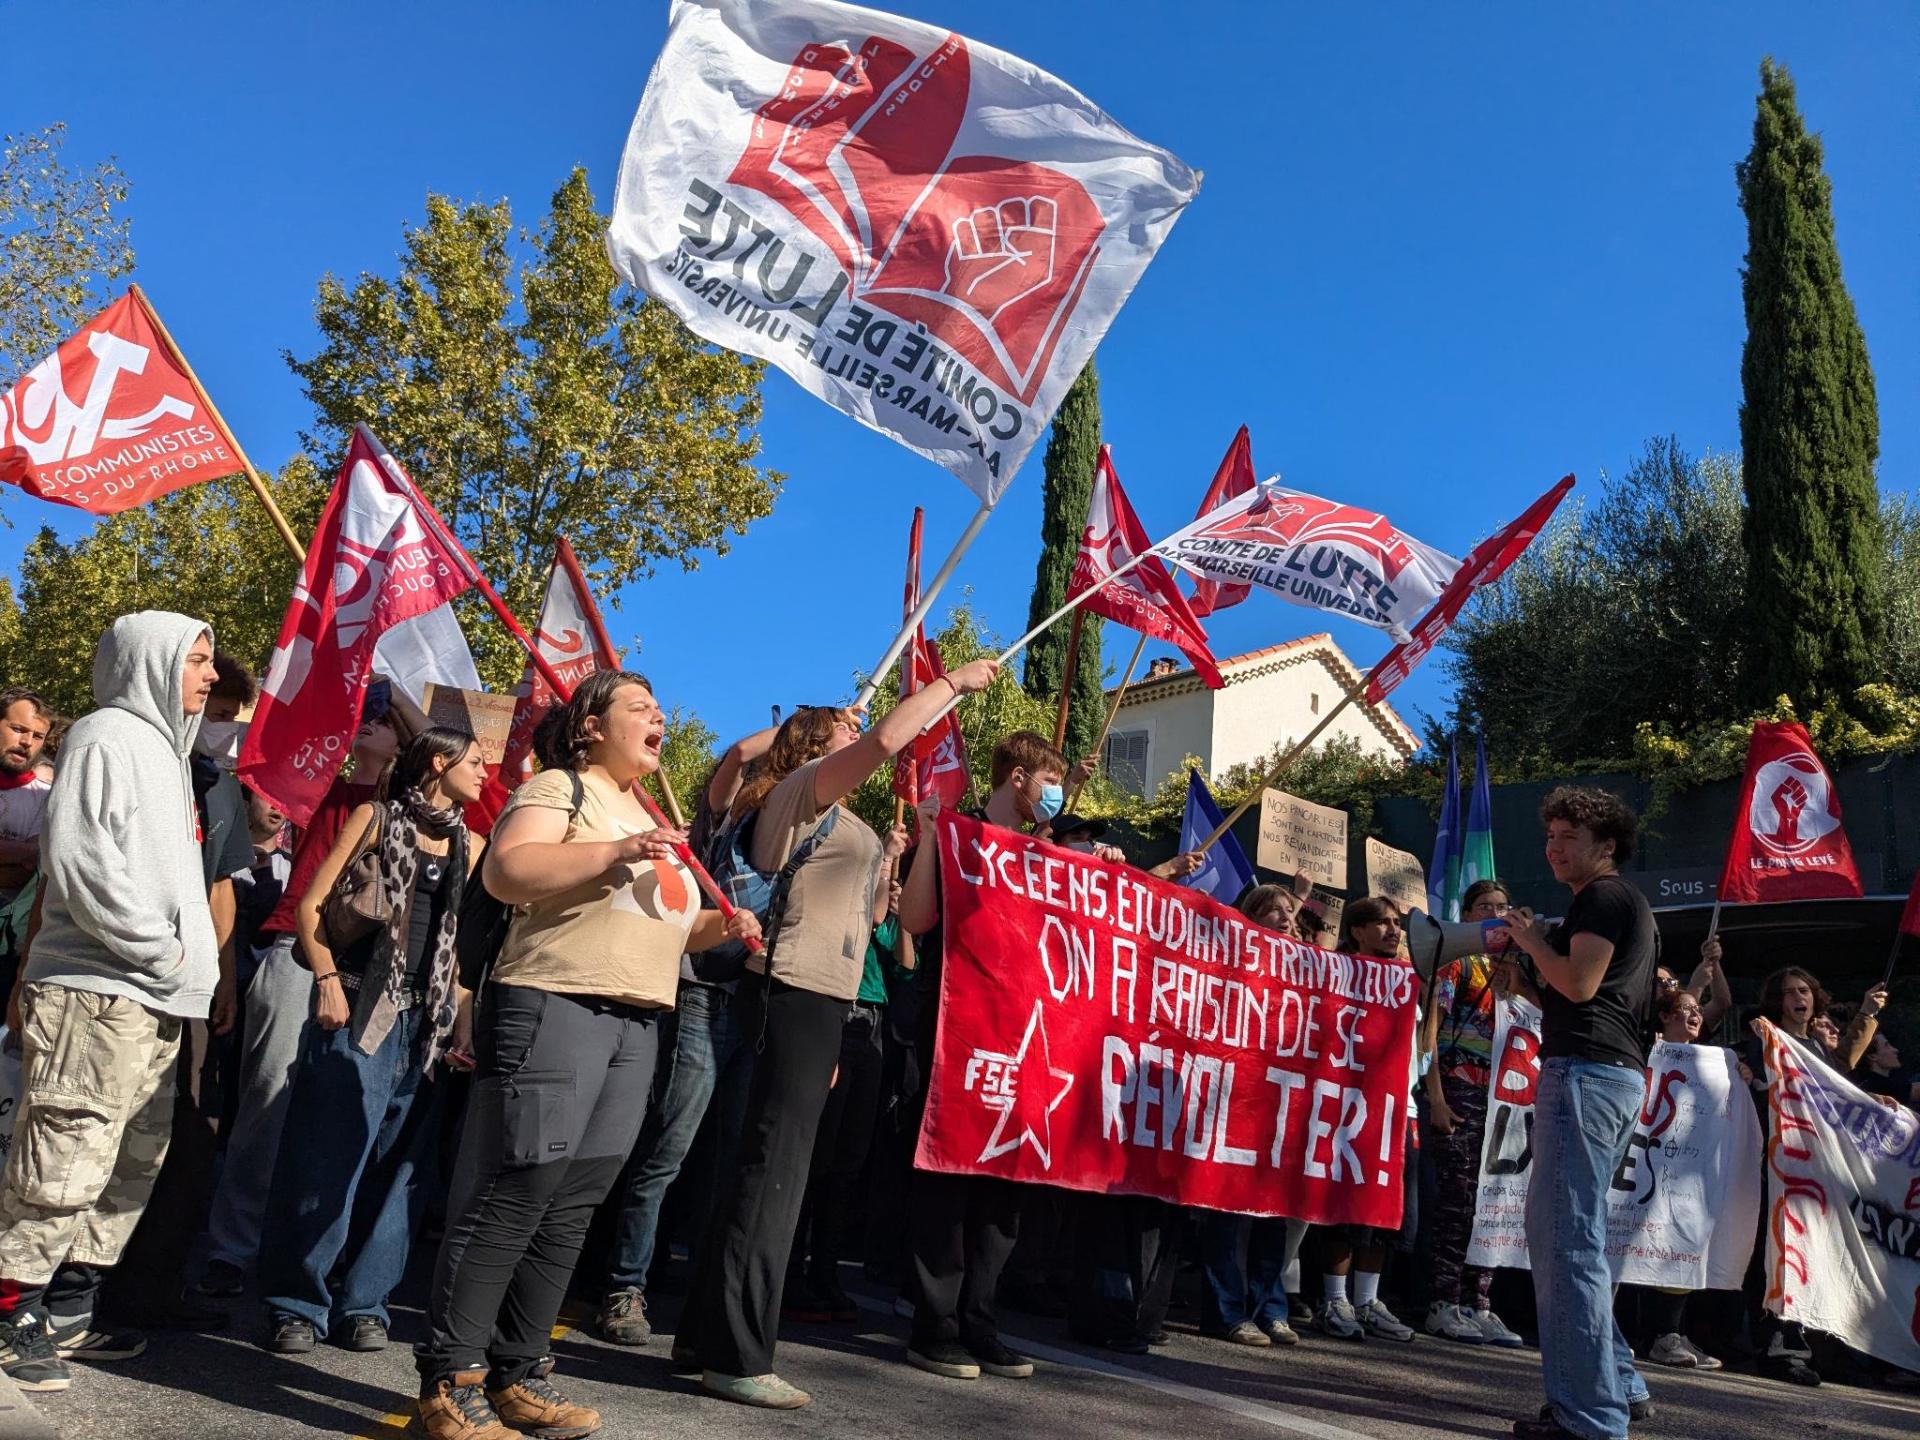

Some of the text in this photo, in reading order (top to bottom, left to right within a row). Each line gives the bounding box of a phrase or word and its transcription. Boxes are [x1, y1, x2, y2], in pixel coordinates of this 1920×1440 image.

[54, 425, 215, 488] COMMUNISTES
[1154, 546, 1288, 591] AIX-MARSEILLE
[1178, 538, 1257, 559] COMITÉ
[1253, 545, 1285, 566] DE
[1284, 543, 1400, 614] LUTTE
[1267, 797, 1288, 814] NOS
[1263, 830, 1281, 843] NOS
[1270, 815, 1293, 832] SONT
[1294, 825, 1304, 834] EN
[1280, 851, 1291, 865] EN
[1751, 857, 1764, 869] LE
[1806, 852, 1837, 867] LEVÉ
[1660, 879, 1704, 897] Sous
[1264, 936, 1416, 1009] TRAVAILLEURS
[1039, 914, 1368, 1073] ON A RAISON DE SE
[965, 1056, 1018, 1098] FSE
